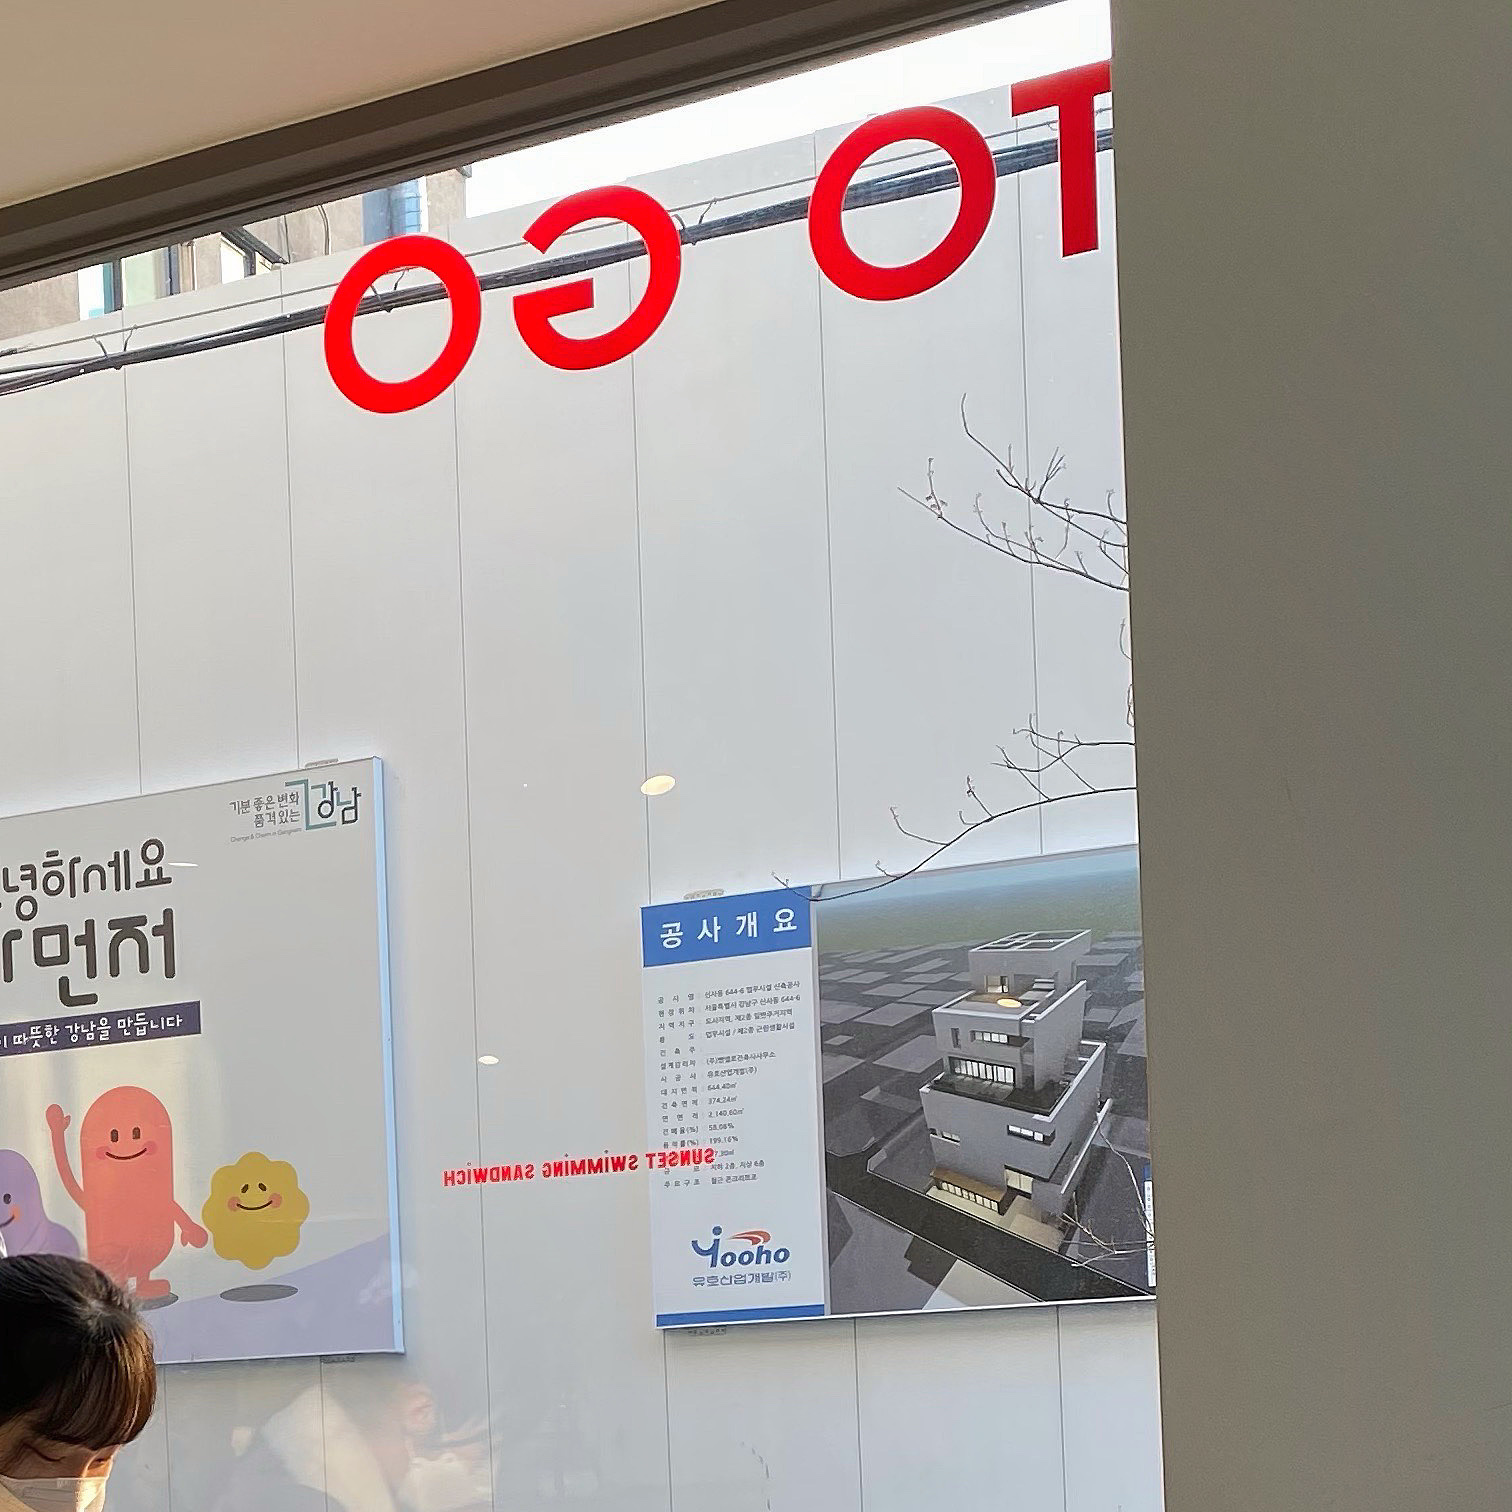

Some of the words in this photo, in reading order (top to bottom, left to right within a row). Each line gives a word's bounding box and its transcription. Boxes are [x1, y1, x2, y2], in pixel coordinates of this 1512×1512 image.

[229, 800, 251, 815] 기분
[253, 795, 275, 811] 좋은
[277, 792, 300, 807] 변화
[311, 781, 362, 825] 강남
[254, 811, 276, 828] 품격
[279, 809, 300, 824] 있는
[13, 1025, 60, 1048] 따뜻한
[65, 1017, 111, 1043] 강남을
[117, 1012, 183, 1036] 만듭니다
[693, 1270, 791, 1287] 유호산업개발(주)
